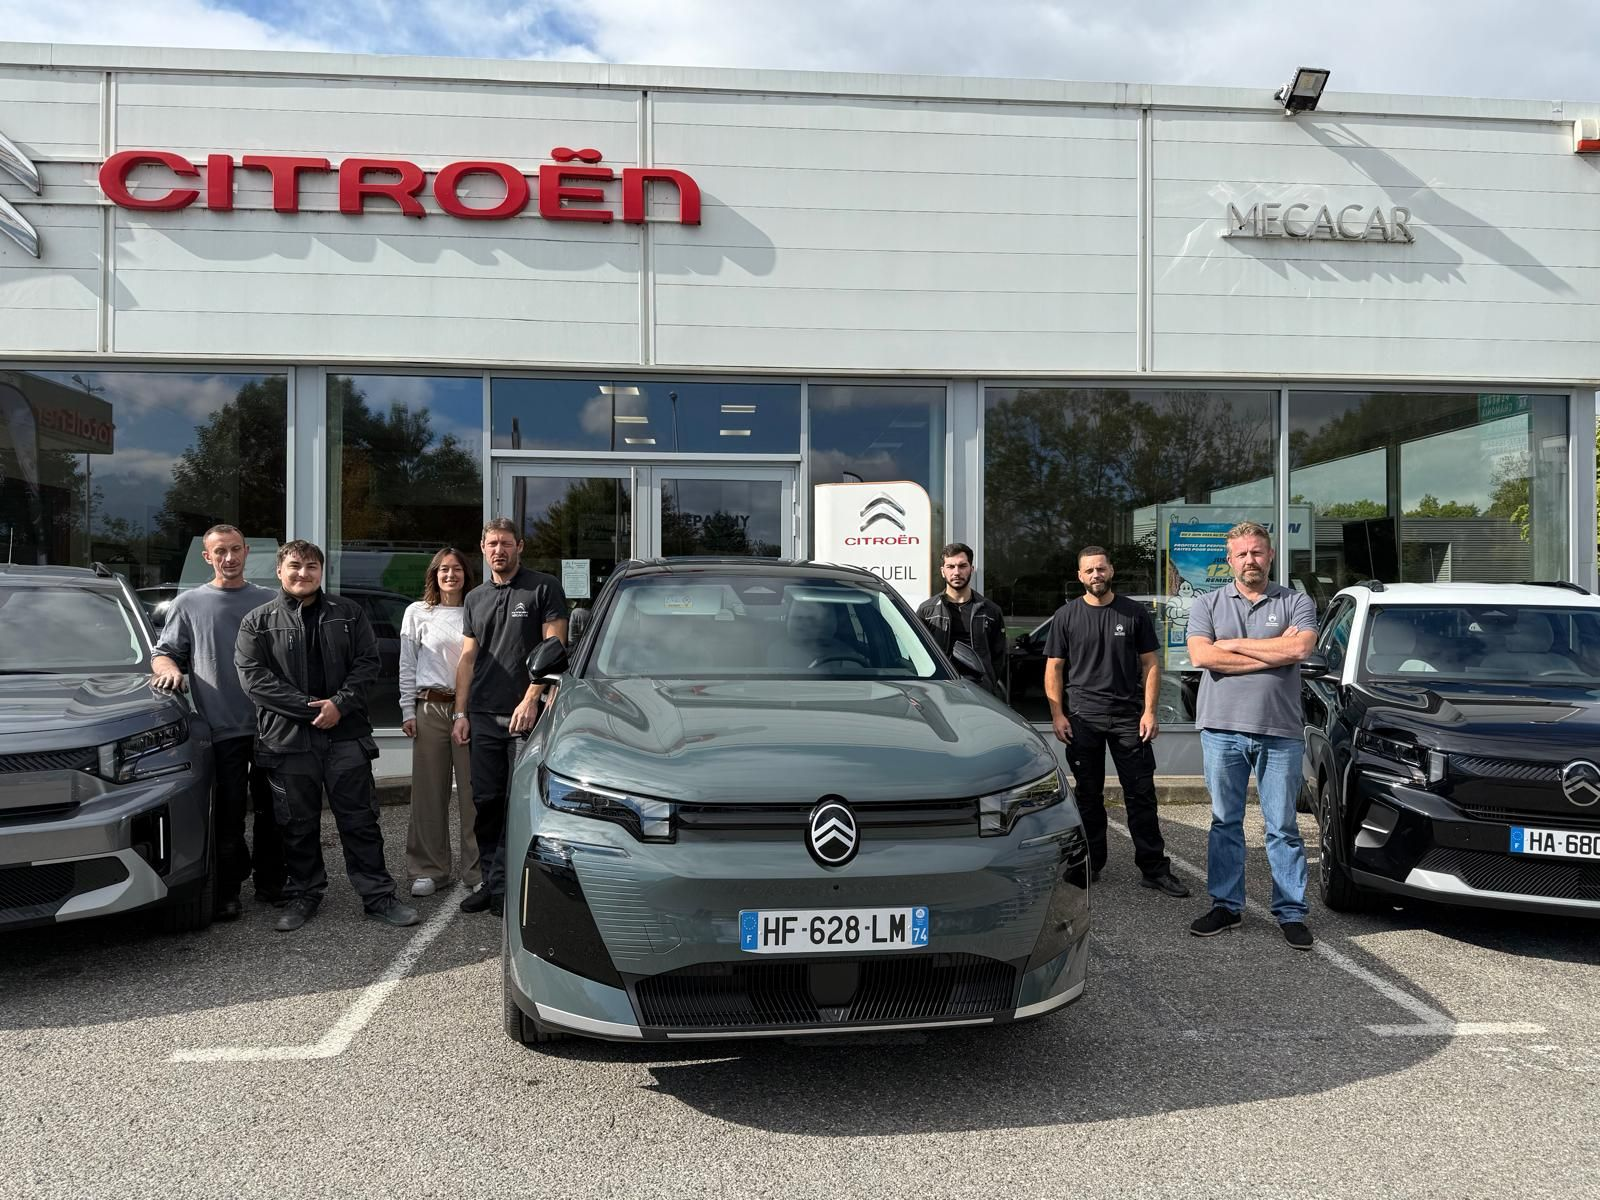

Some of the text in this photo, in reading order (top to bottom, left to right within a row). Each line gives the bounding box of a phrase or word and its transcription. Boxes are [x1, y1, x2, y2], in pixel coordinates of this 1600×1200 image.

[1225, 201, 1415, 243] MECACAR
[861, 566, 917, 580] UEIL
[746, 935, 752, 944] F
[763, 913, 906, 946] HF-628-LM
[912, 927, 928, 942] 74
